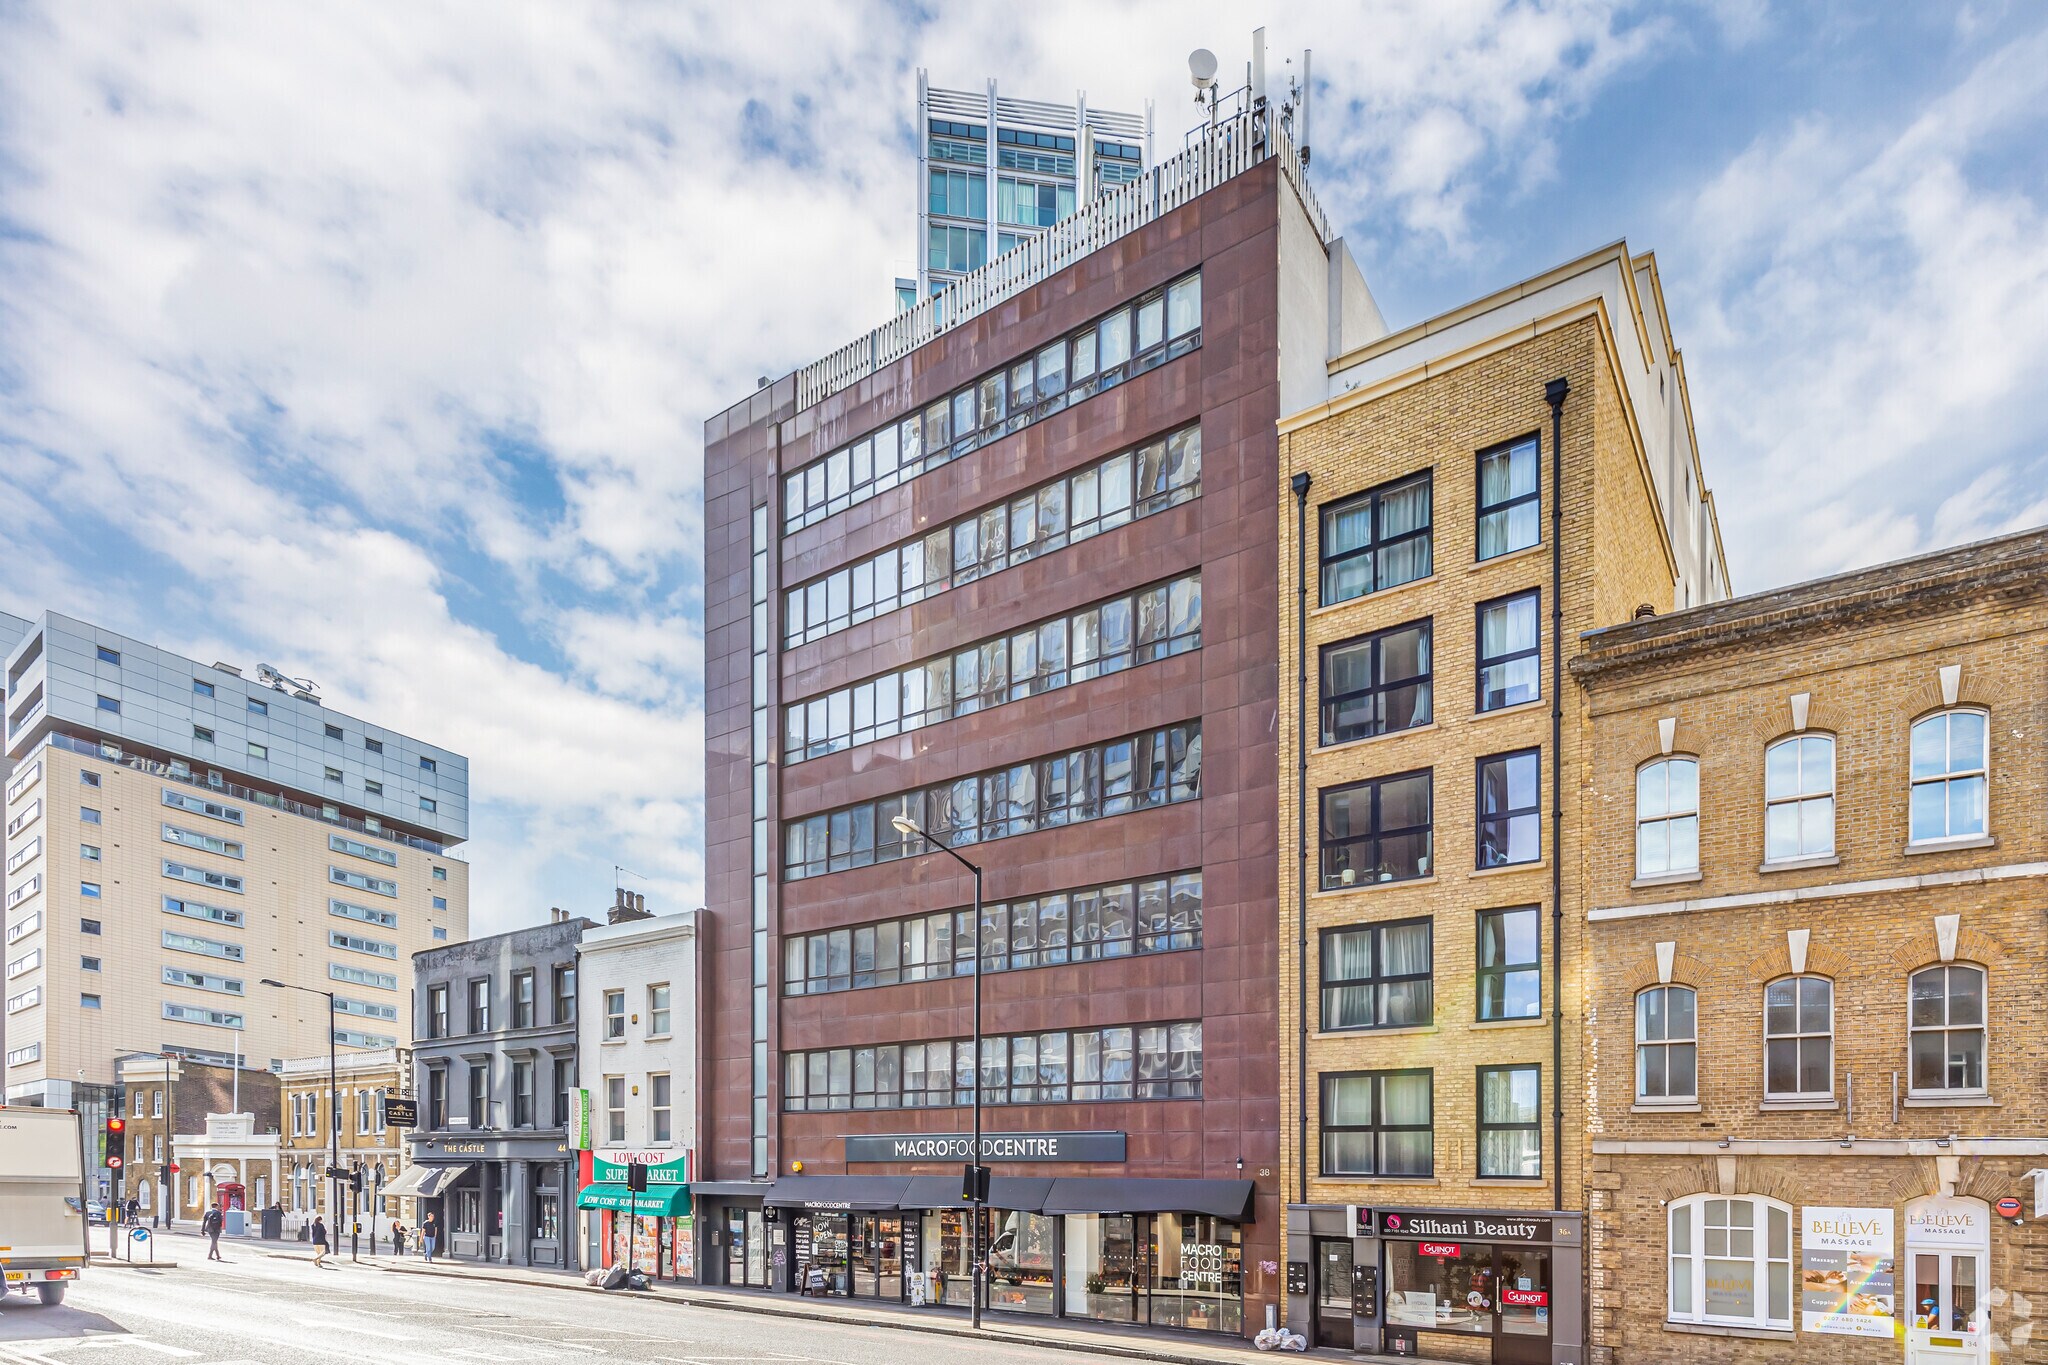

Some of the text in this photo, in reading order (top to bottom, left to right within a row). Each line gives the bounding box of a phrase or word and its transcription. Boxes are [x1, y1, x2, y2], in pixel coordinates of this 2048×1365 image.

[444, 1144, 485, 1153] THE CASTLE
[557, 1144, 566, 1152] 44
[613, 1152, 665, 1163] LOW COST
[605, 1168, 679, 1181] SUPEARKET
[1259, 1168, 1270, 1176] 38
[584, 1195, 599, 1203] LOW
[600, 1197, 617, 1206] COST
[804, 1201, 851, 1209] MACROFOODCENTRE
[813, 1219, 830, 1232] NOW
[1409, 1219, 1536, 1239] Silhani Beauty
[1812, 1219, 1884, 1237] BELIEVE
[814, 1229, 833, 1243] OPEN
[1821, 1238, 1872, 1246] MASSAGE
[1180, 1243, 1222, 1256] MACRO
[1423, 1243, 1456, 1254] GUINOT
[1181, 1256, 1222, 1271] FOOD
[1181, 1271, 1222, 1283] CENTRE
[1508, 1291, 1542, 1302] GUINOT
